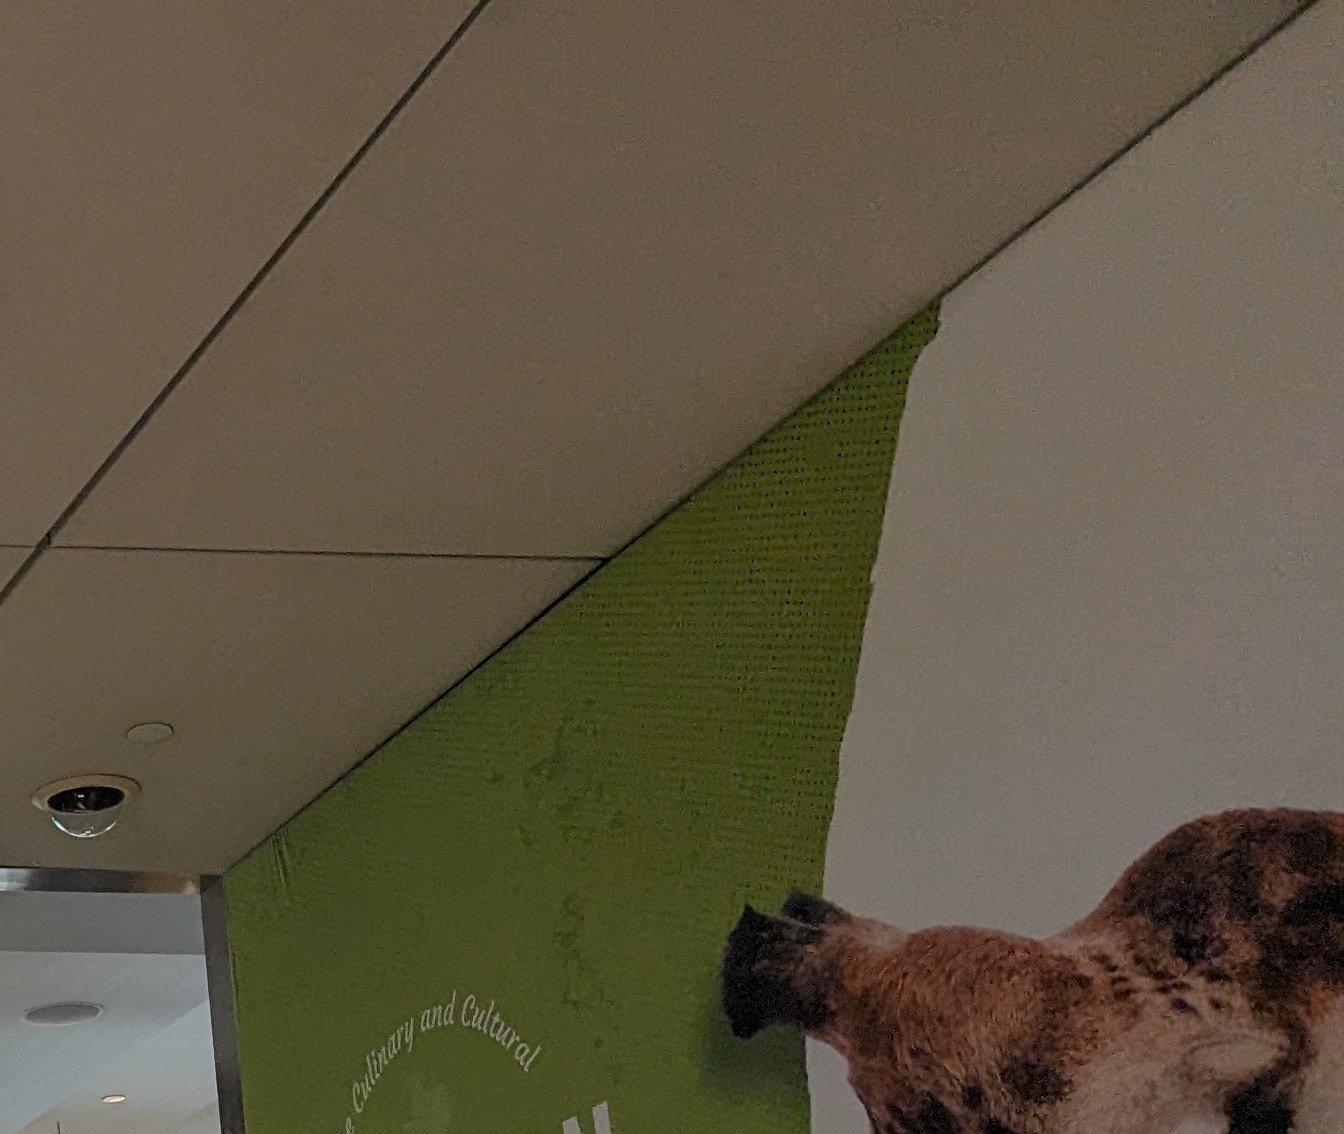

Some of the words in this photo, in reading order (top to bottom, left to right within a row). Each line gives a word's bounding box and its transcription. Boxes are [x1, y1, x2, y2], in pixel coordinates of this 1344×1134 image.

[351, 1017, 415, 1115] Culinary
[420, 989, 457, 1032] and
[461, 994, 543, 1073] Cultural
